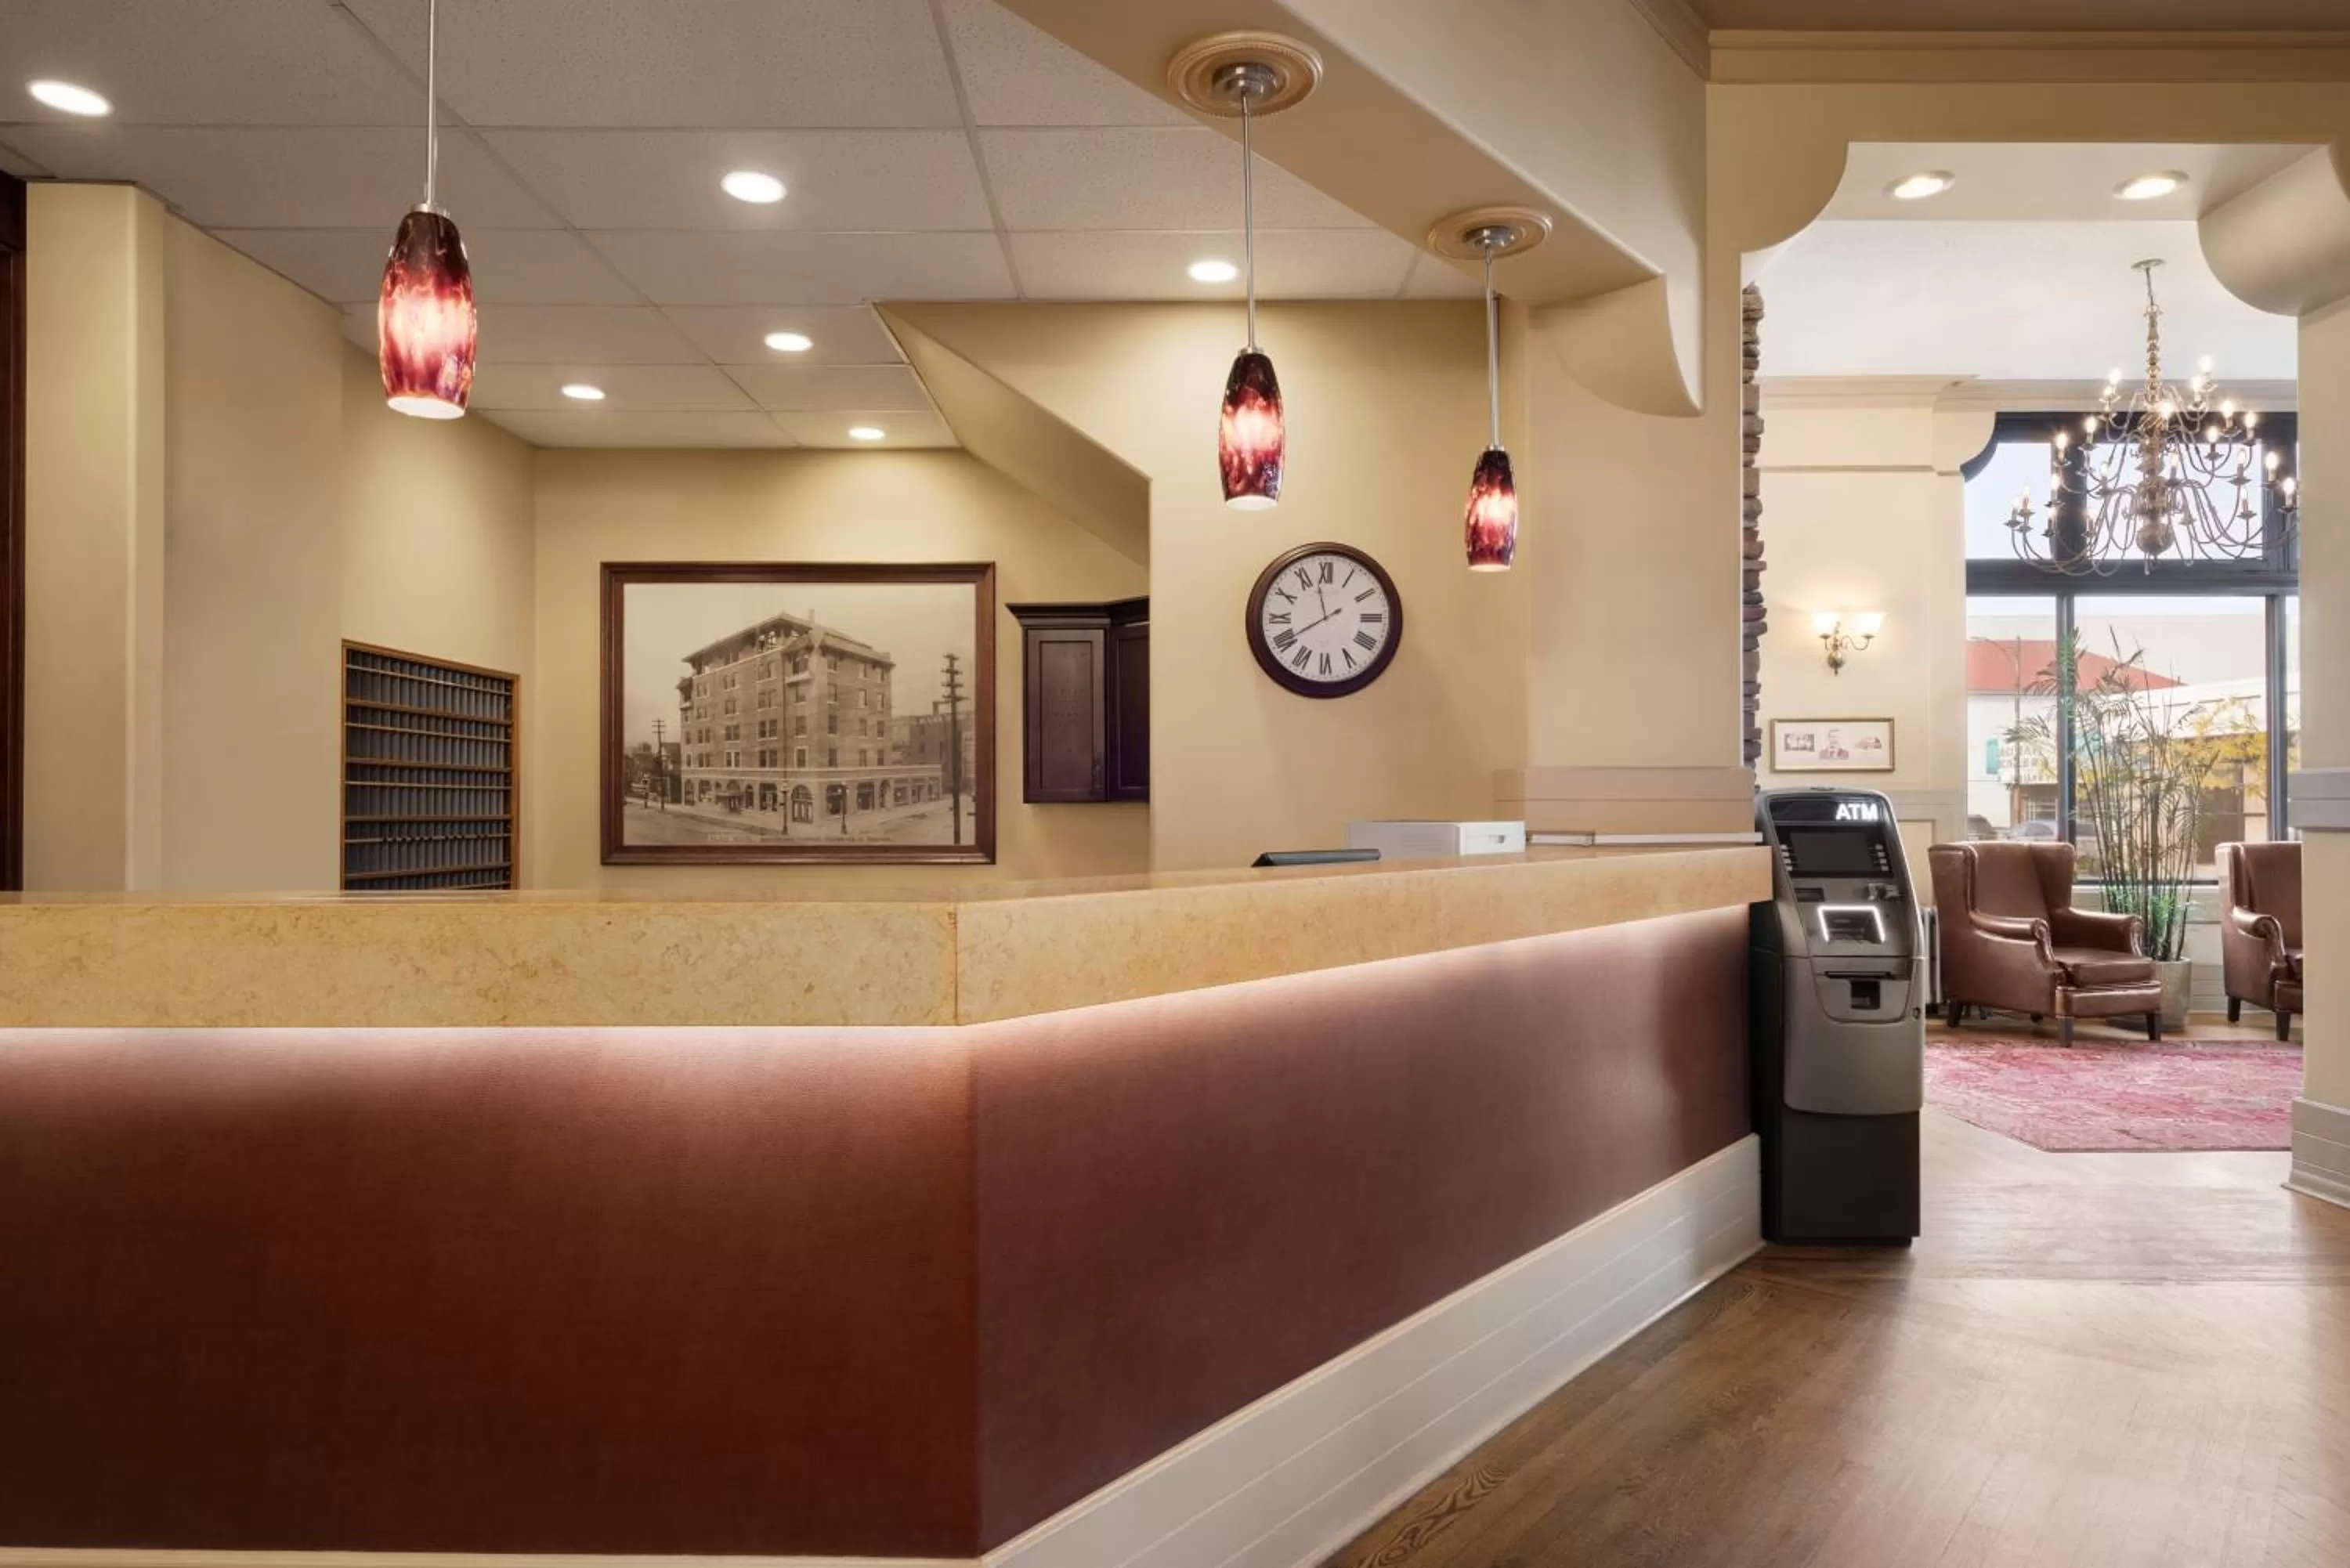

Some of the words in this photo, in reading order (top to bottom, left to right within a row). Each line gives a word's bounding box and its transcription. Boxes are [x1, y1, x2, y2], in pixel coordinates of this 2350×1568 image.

[1318, 562, 1333, 583] XII
[1275, 587, 1297, 605] X
[1319, 652, 1332, 674] VI
[1341, 648, 1357, 669] V
[1835, 803, 1878, 821] ATM
